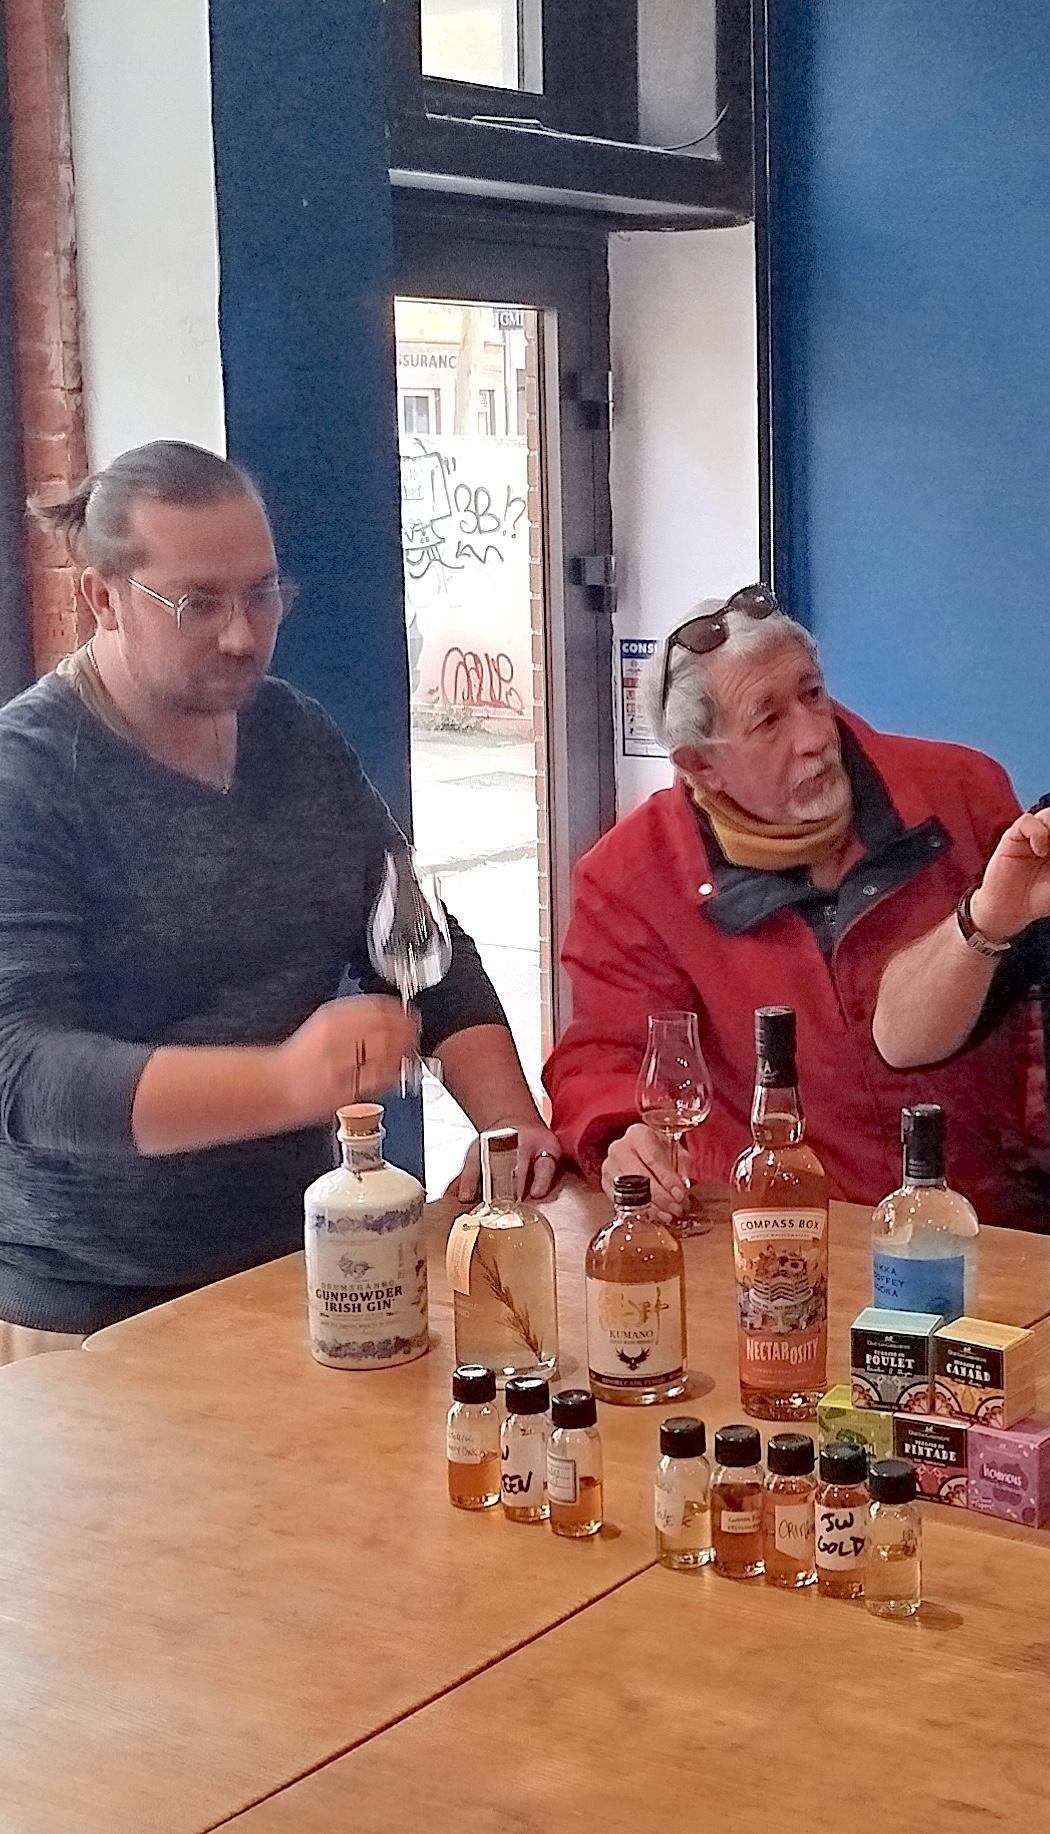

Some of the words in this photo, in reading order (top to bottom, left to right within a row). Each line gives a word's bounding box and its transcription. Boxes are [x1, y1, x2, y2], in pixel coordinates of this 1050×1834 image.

[740, 1218, 795, 1231] COMPASS
[799, 1218, 819, 1230] BOX
[315, 1286, 403, 1302] GUNPOWDER
[325, 1302, 361, 1312] IRISH
[366, 1299, 392, 1312] GIN
[609, 1330, 654, 1339] KUMANO
[746, 1338, 819, 1365] NECTAROSITY
[865, 1354, 916, 1369] POULET
[946, 1363, 991, 1382] CANARD
[904, 1443, 957, 1462] PINTADE
[820, 1512, 854, 1532] JW
[818, 1536, 865, 1557] GOLD
